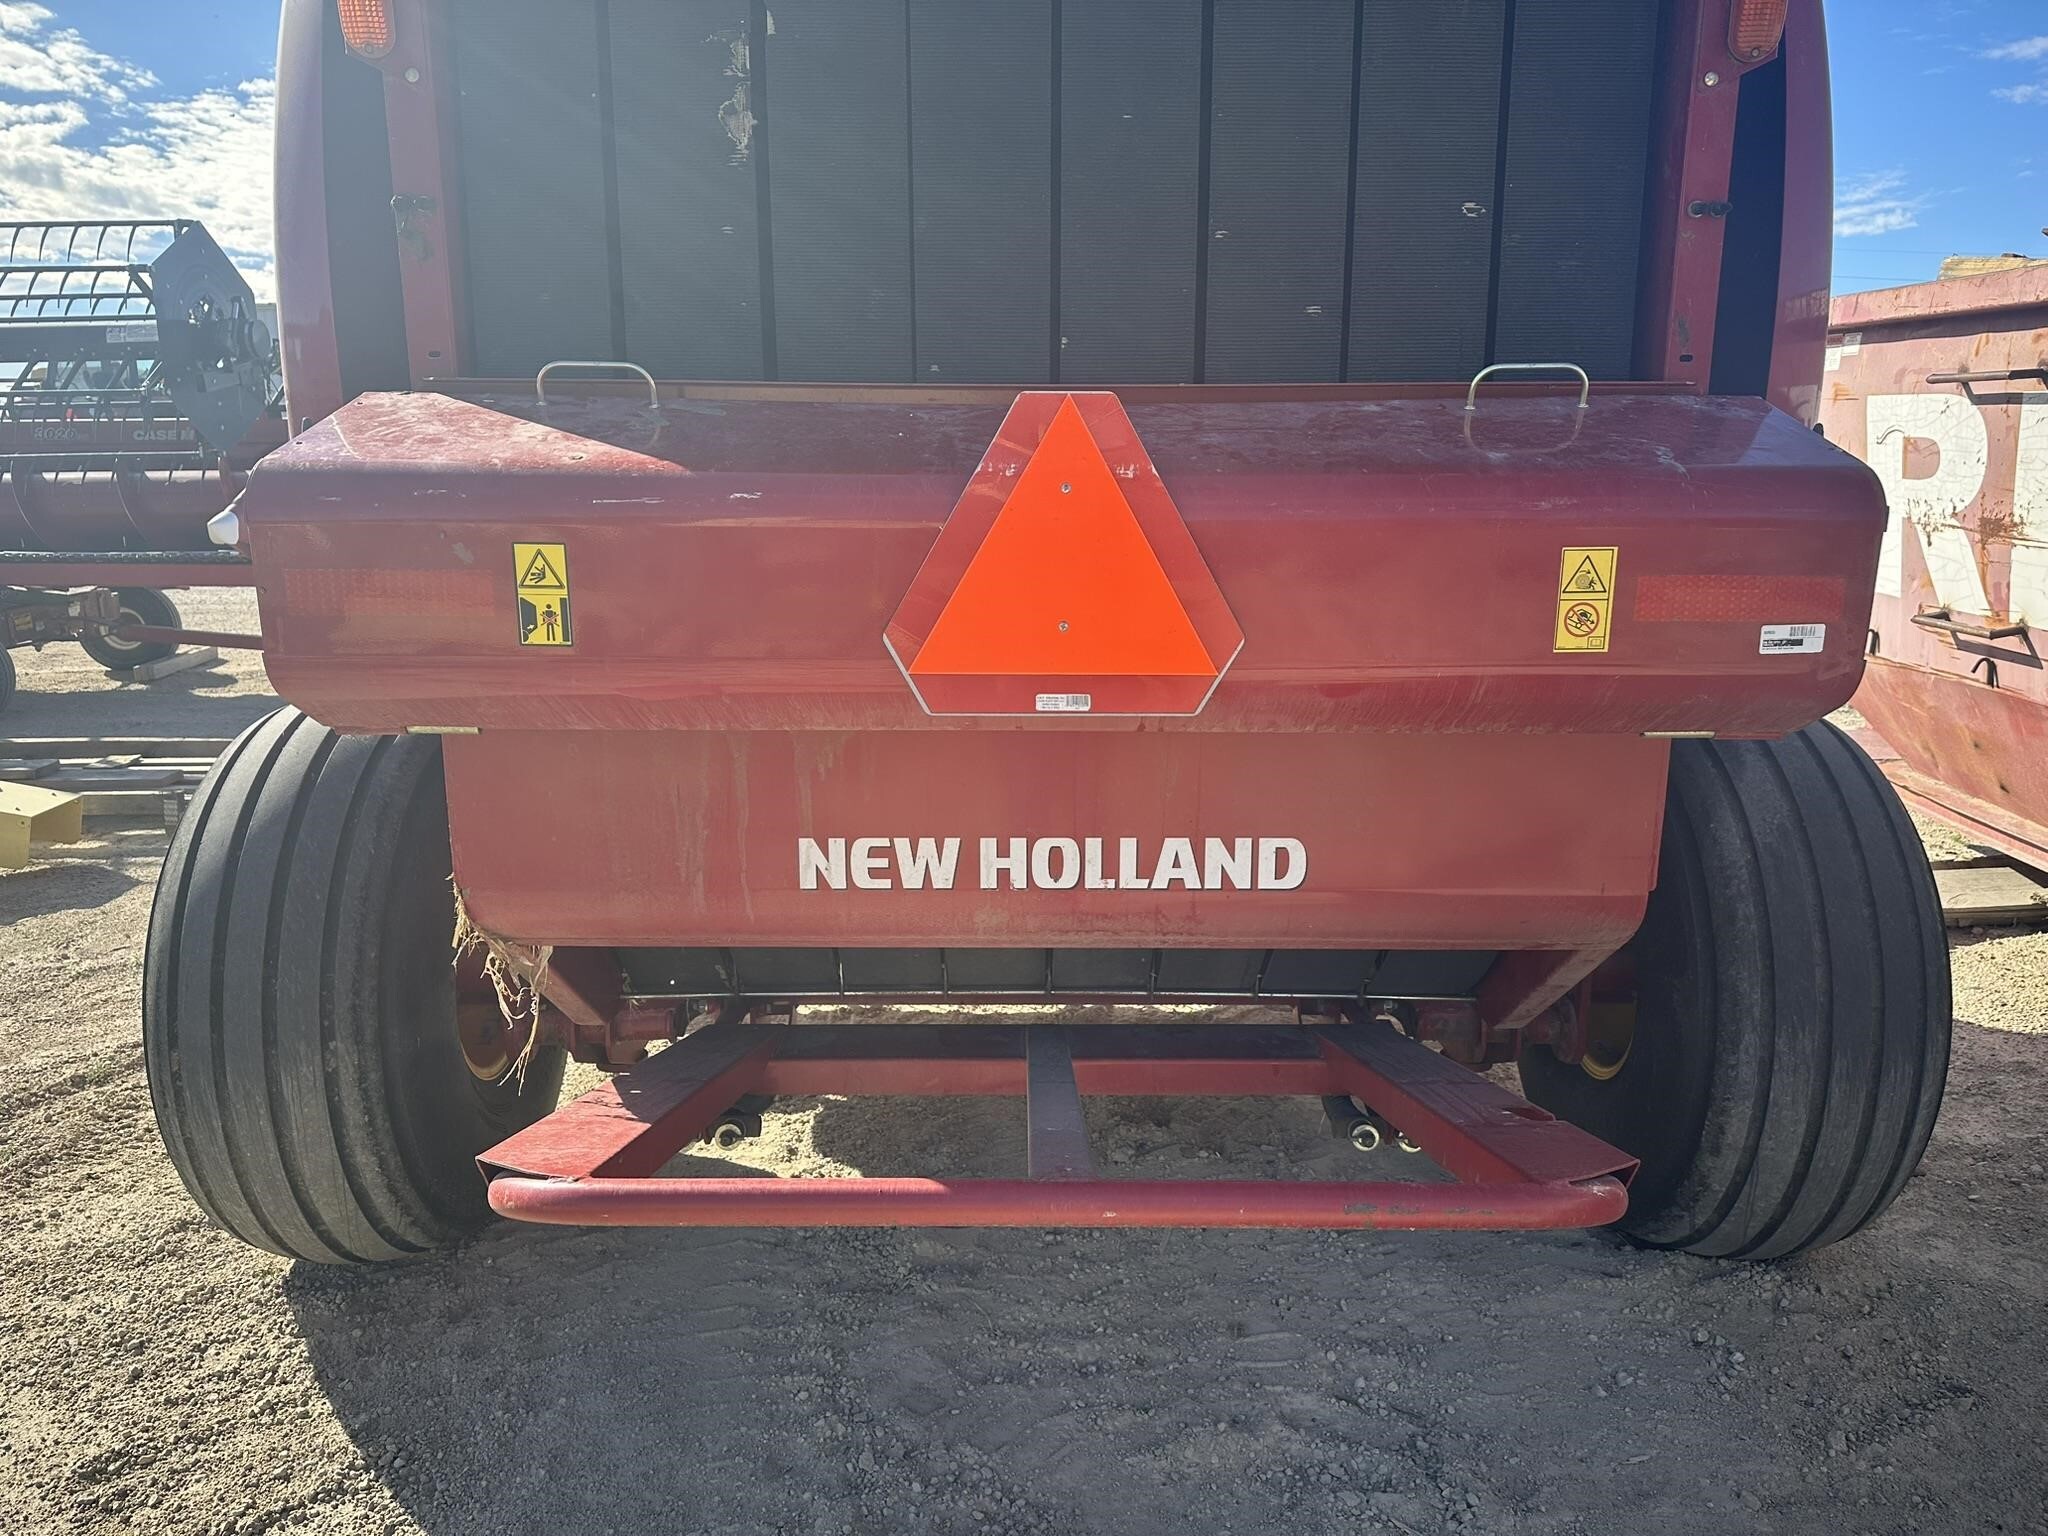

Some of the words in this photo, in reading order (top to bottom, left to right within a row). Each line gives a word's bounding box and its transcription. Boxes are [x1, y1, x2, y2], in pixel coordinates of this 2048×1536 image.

[133, 430, 177, 441] CASE
[798, 837, 961, 889] NEW
[979, 837, 1308, 890] HOLLAND
